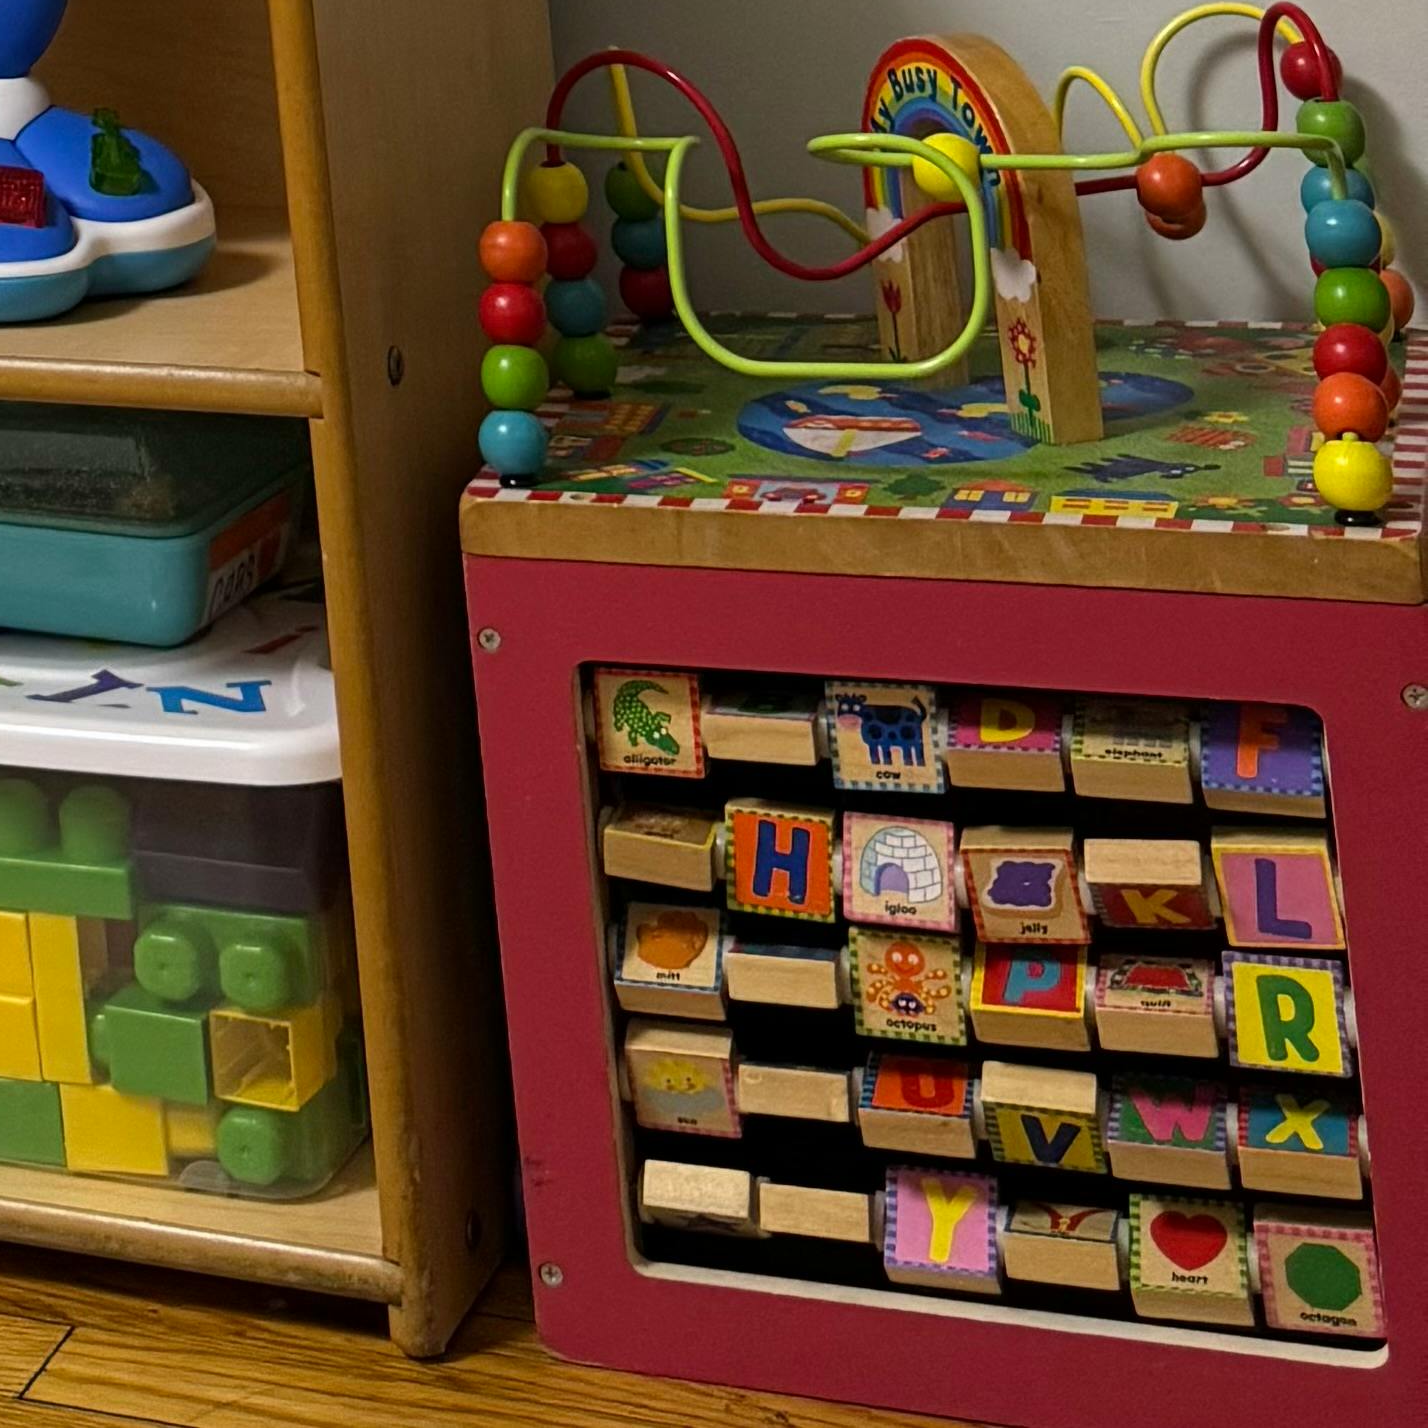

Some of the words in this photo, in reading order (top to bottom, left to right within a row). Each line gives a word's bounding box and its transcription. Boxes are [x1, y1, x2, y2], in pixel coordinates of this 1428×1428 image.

[978, 696, 1036, 742] D
[1236, 704, 1290, 779] F
[623, 754, 677, 768] alligator
[876, 770, 902, 781] cow
[1104, 747, 1164, 761] elephant
[752, 819, 811, 906] H
[884, 901, 917, 917] igloo
[1120, 889, 1193, 925] K
[1255, 857, 1312, 939] L
[1019, 922, 1049, 935] jelly
[656, 970, 681, 982] mitt
[1002, 946, 1062, 1003] P
[886, 1019, 938, 1032] octopus
[1255, 974, 1320, 1063] R
[900, 1059, 956, 1109] U
[1128, 1084, 1216, 1143] W
[1265, 1093, 1332, 1151] X
[1021, 1113, 1082, 1164] V
[921, 1177, 978, 1264] Y
[1171, 1271, 1209, 1286] heart
[1299, 1311, 1358, 1327] octagon
